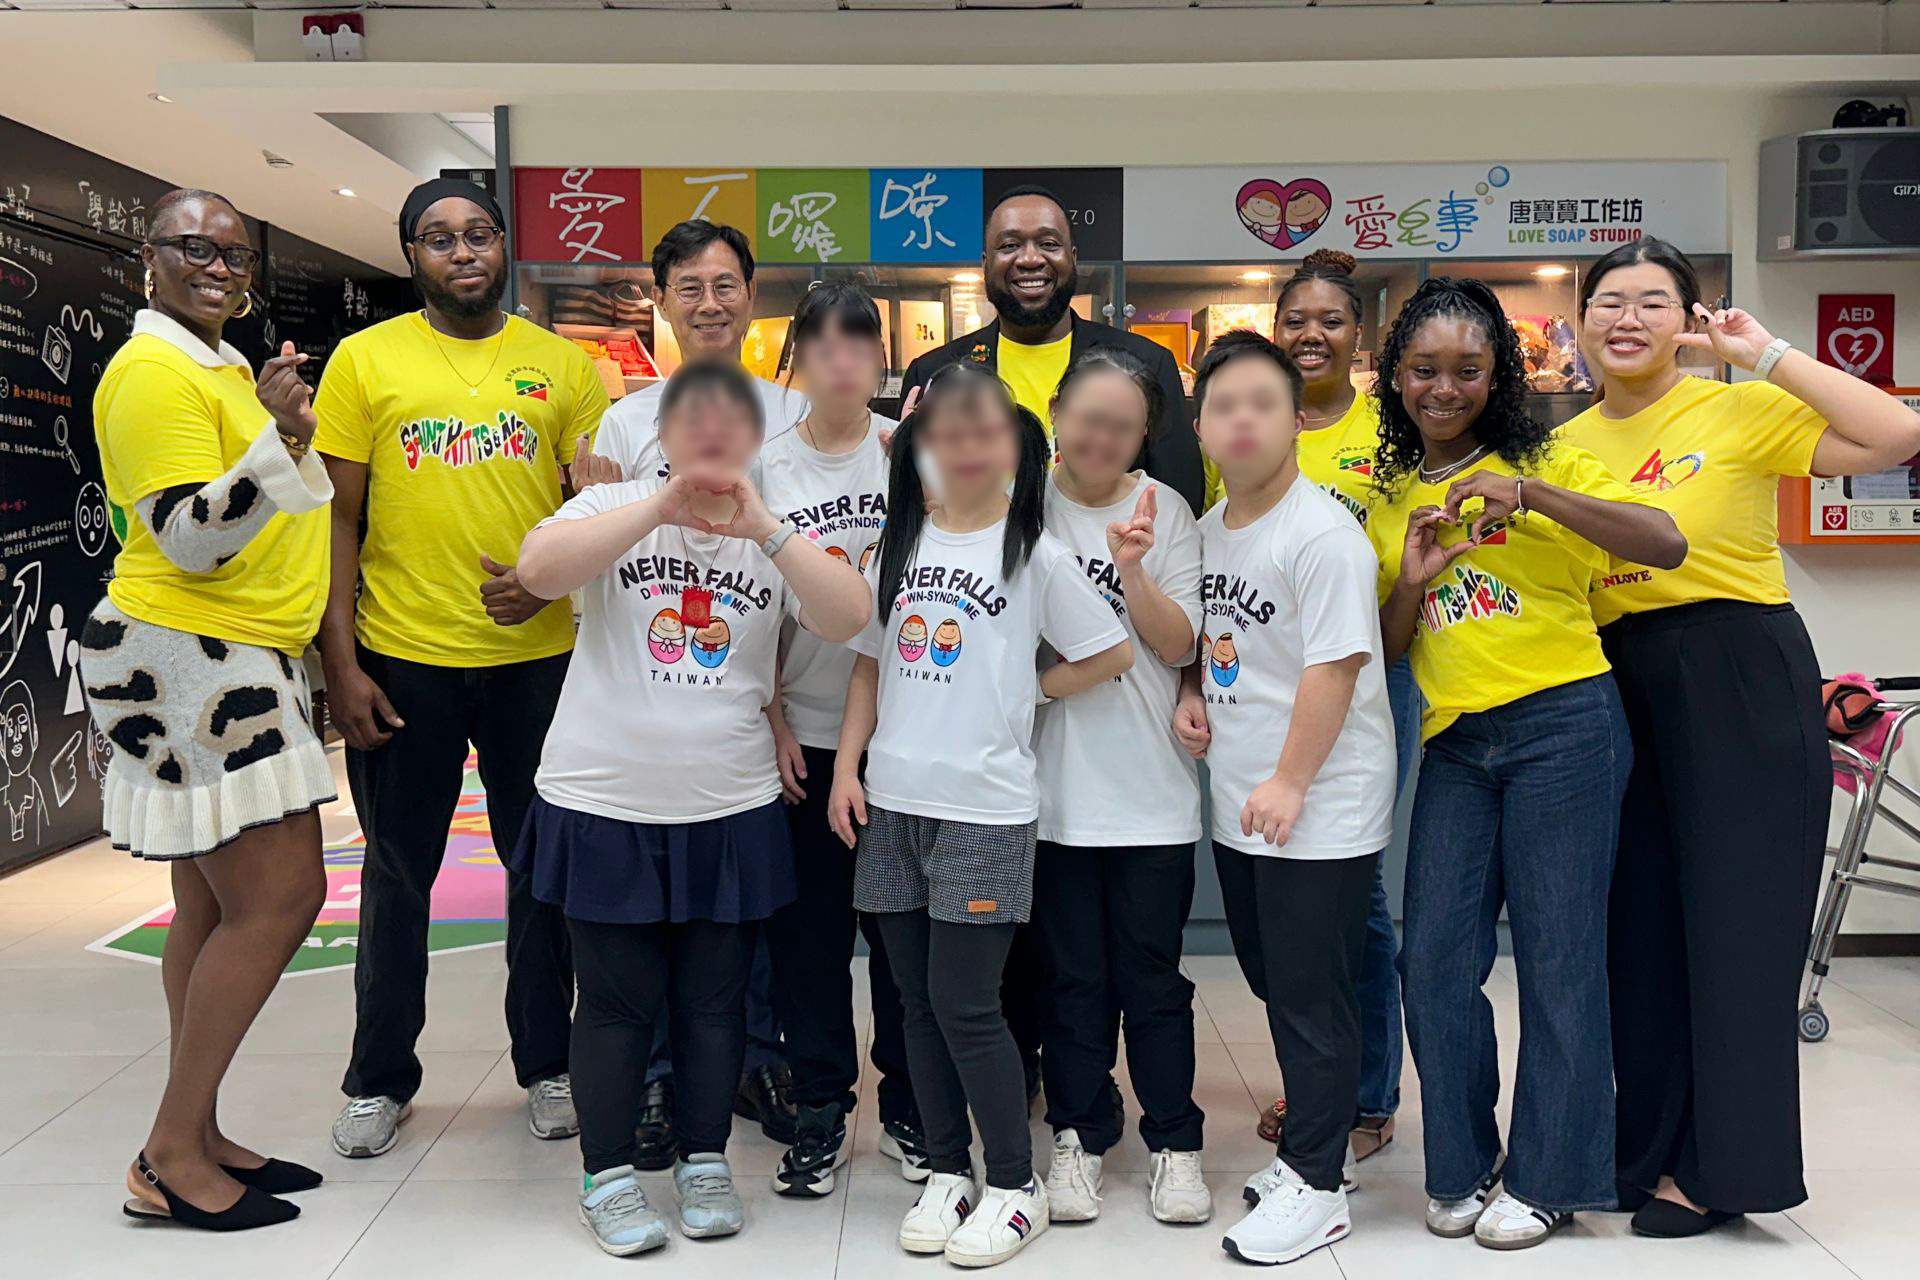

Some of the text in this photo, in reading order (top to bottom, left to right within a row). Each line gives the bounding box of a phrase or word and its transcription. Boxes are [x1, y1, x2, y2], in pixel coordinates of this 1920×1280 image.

[1508, 198, 1643, 224] 唐寶寶工作坊
[1508, 228, 1642, 243] LOVE SOAP STUDIO
[1837, 307, 1875, 322] AED
[786, 494, 854, 529] EVER
[618, 555, 772, 610] NEVER FALLS
[947, 568, 1008, 617] FALLS
[894, 590, 981, 621] DOWN-SYNDROME
[1228, 574, 1276, 625] ALLS
[651, 669, 723, 686] TAIWAN
[899, 667, 952, 684] TAIWAN
[1207, 693, 1237, 704] WAN
